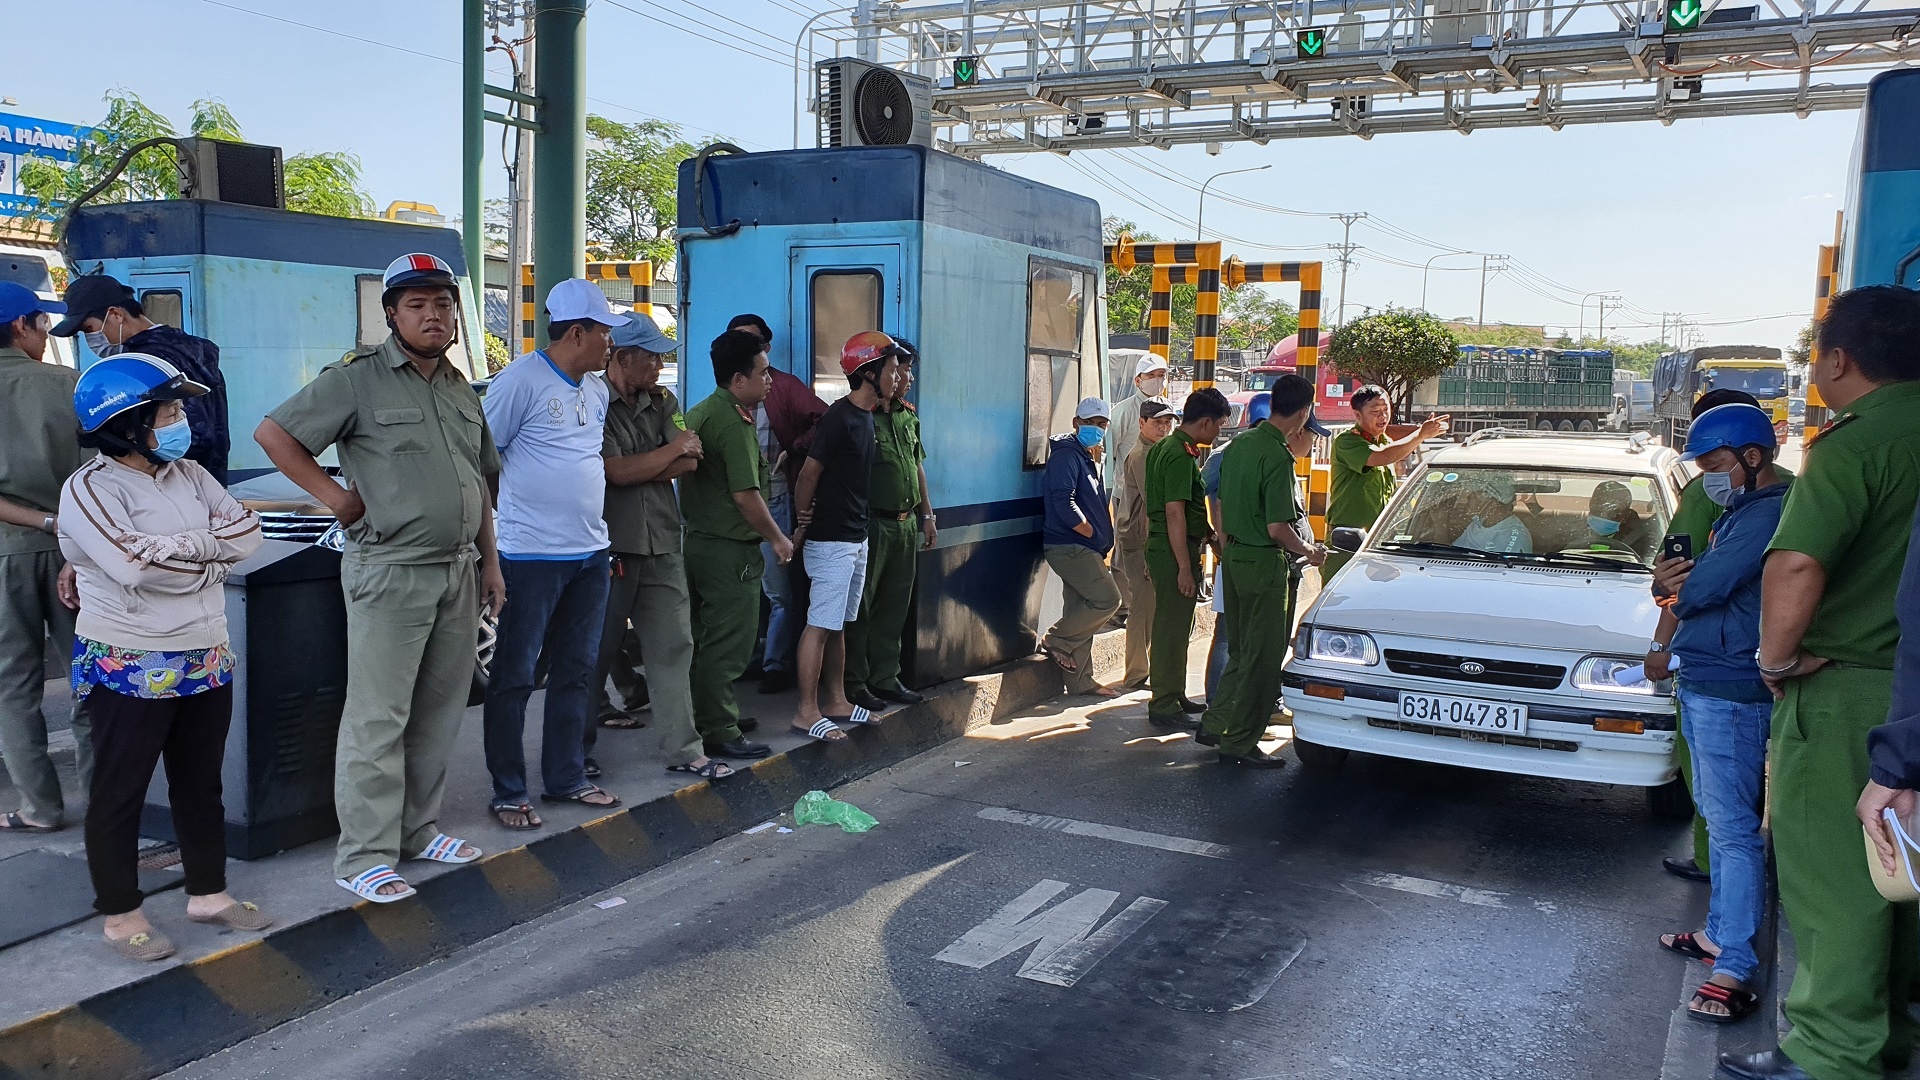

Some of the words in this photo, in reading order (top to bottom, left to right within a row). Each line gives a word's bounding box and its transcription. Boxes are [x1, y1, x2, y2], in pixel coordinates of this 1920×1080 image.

[15, 126, 77, 151] HÀNG
[88, 391, 127, 417] Sacombank
[1464, 664, 1481, 672] KIA
[1403, 695, 1520, 731] 63A-047.81
